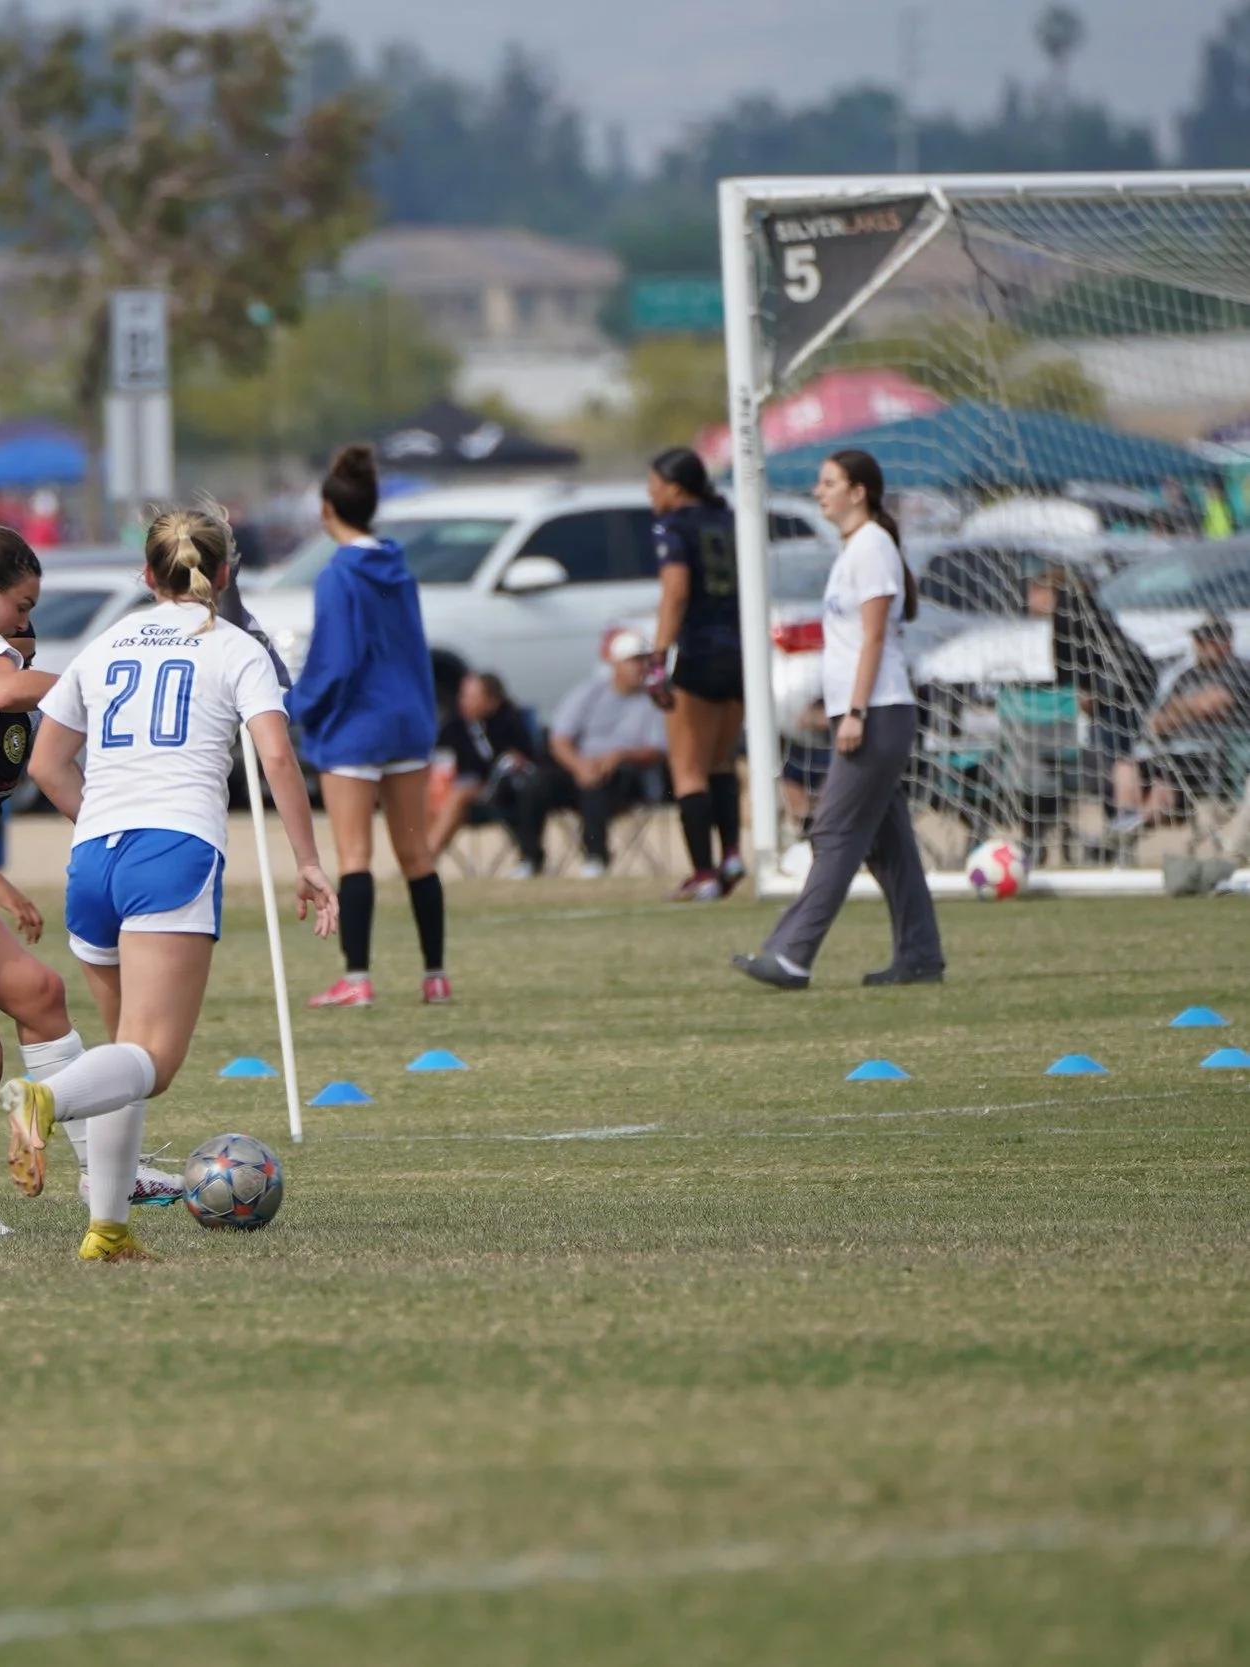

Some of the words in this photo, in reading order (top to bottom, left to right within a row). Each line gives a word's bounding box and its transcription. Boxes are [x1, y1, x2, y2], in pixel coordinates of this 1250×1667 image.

[783, 244, 822, 303] 5
[112, 638, 137, 648] LOS
[138, 637, 203, 647] ANGELES
[102, 659, 195, 748] 20
